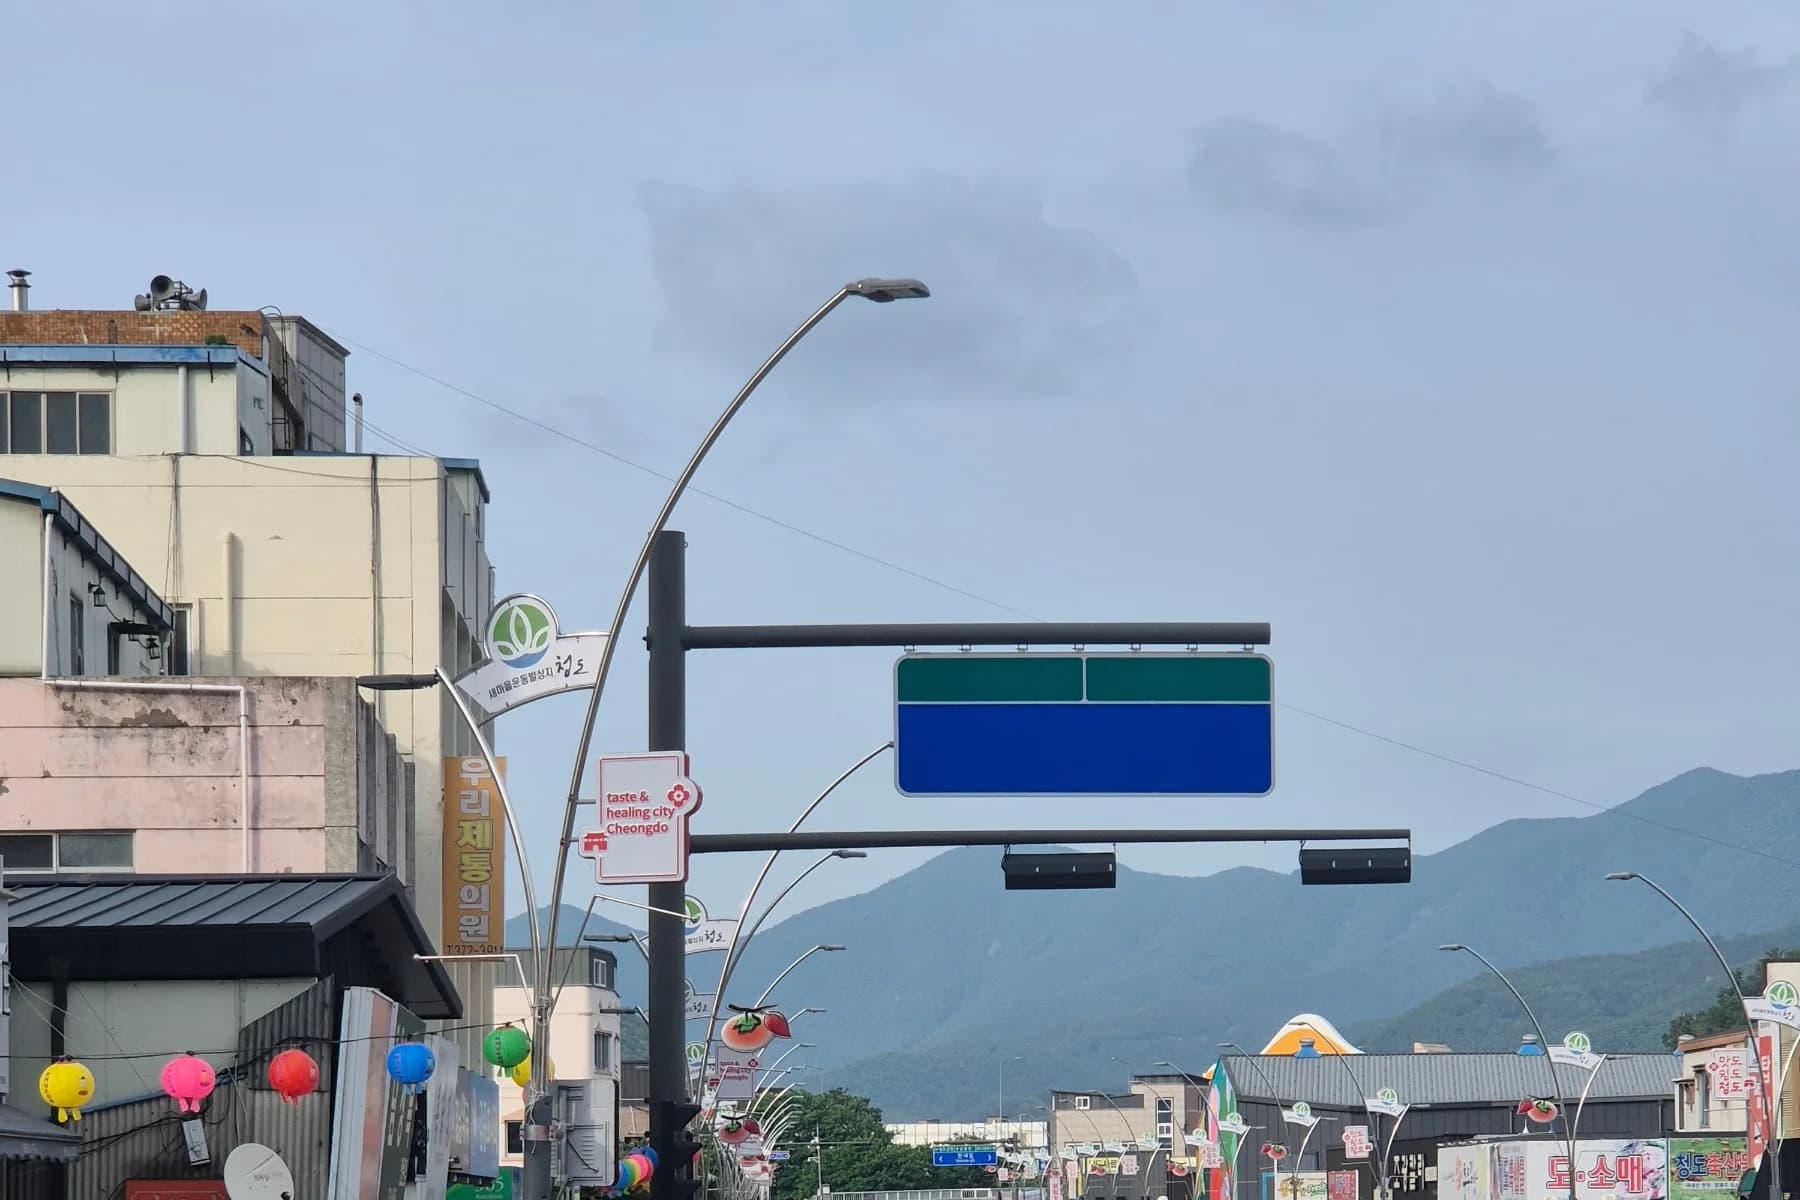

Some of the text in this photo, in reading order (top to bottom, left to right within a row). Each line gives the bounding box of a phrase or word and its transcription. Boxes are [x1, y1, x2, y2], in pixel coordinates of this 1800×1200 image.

[488, 654, 589, 699] 새마을운동발상지 청도
[607, 791, 649, 803] taste &
[607, 806, 675, 819] healing city
[607, 822, 669, 835] Cheongdo
[1719, 1056, 1743, 1068] 맛도
[1719, 1082, 1743, 1095] 청도
[1546, 1154, 1644, 1194] 도·소매
